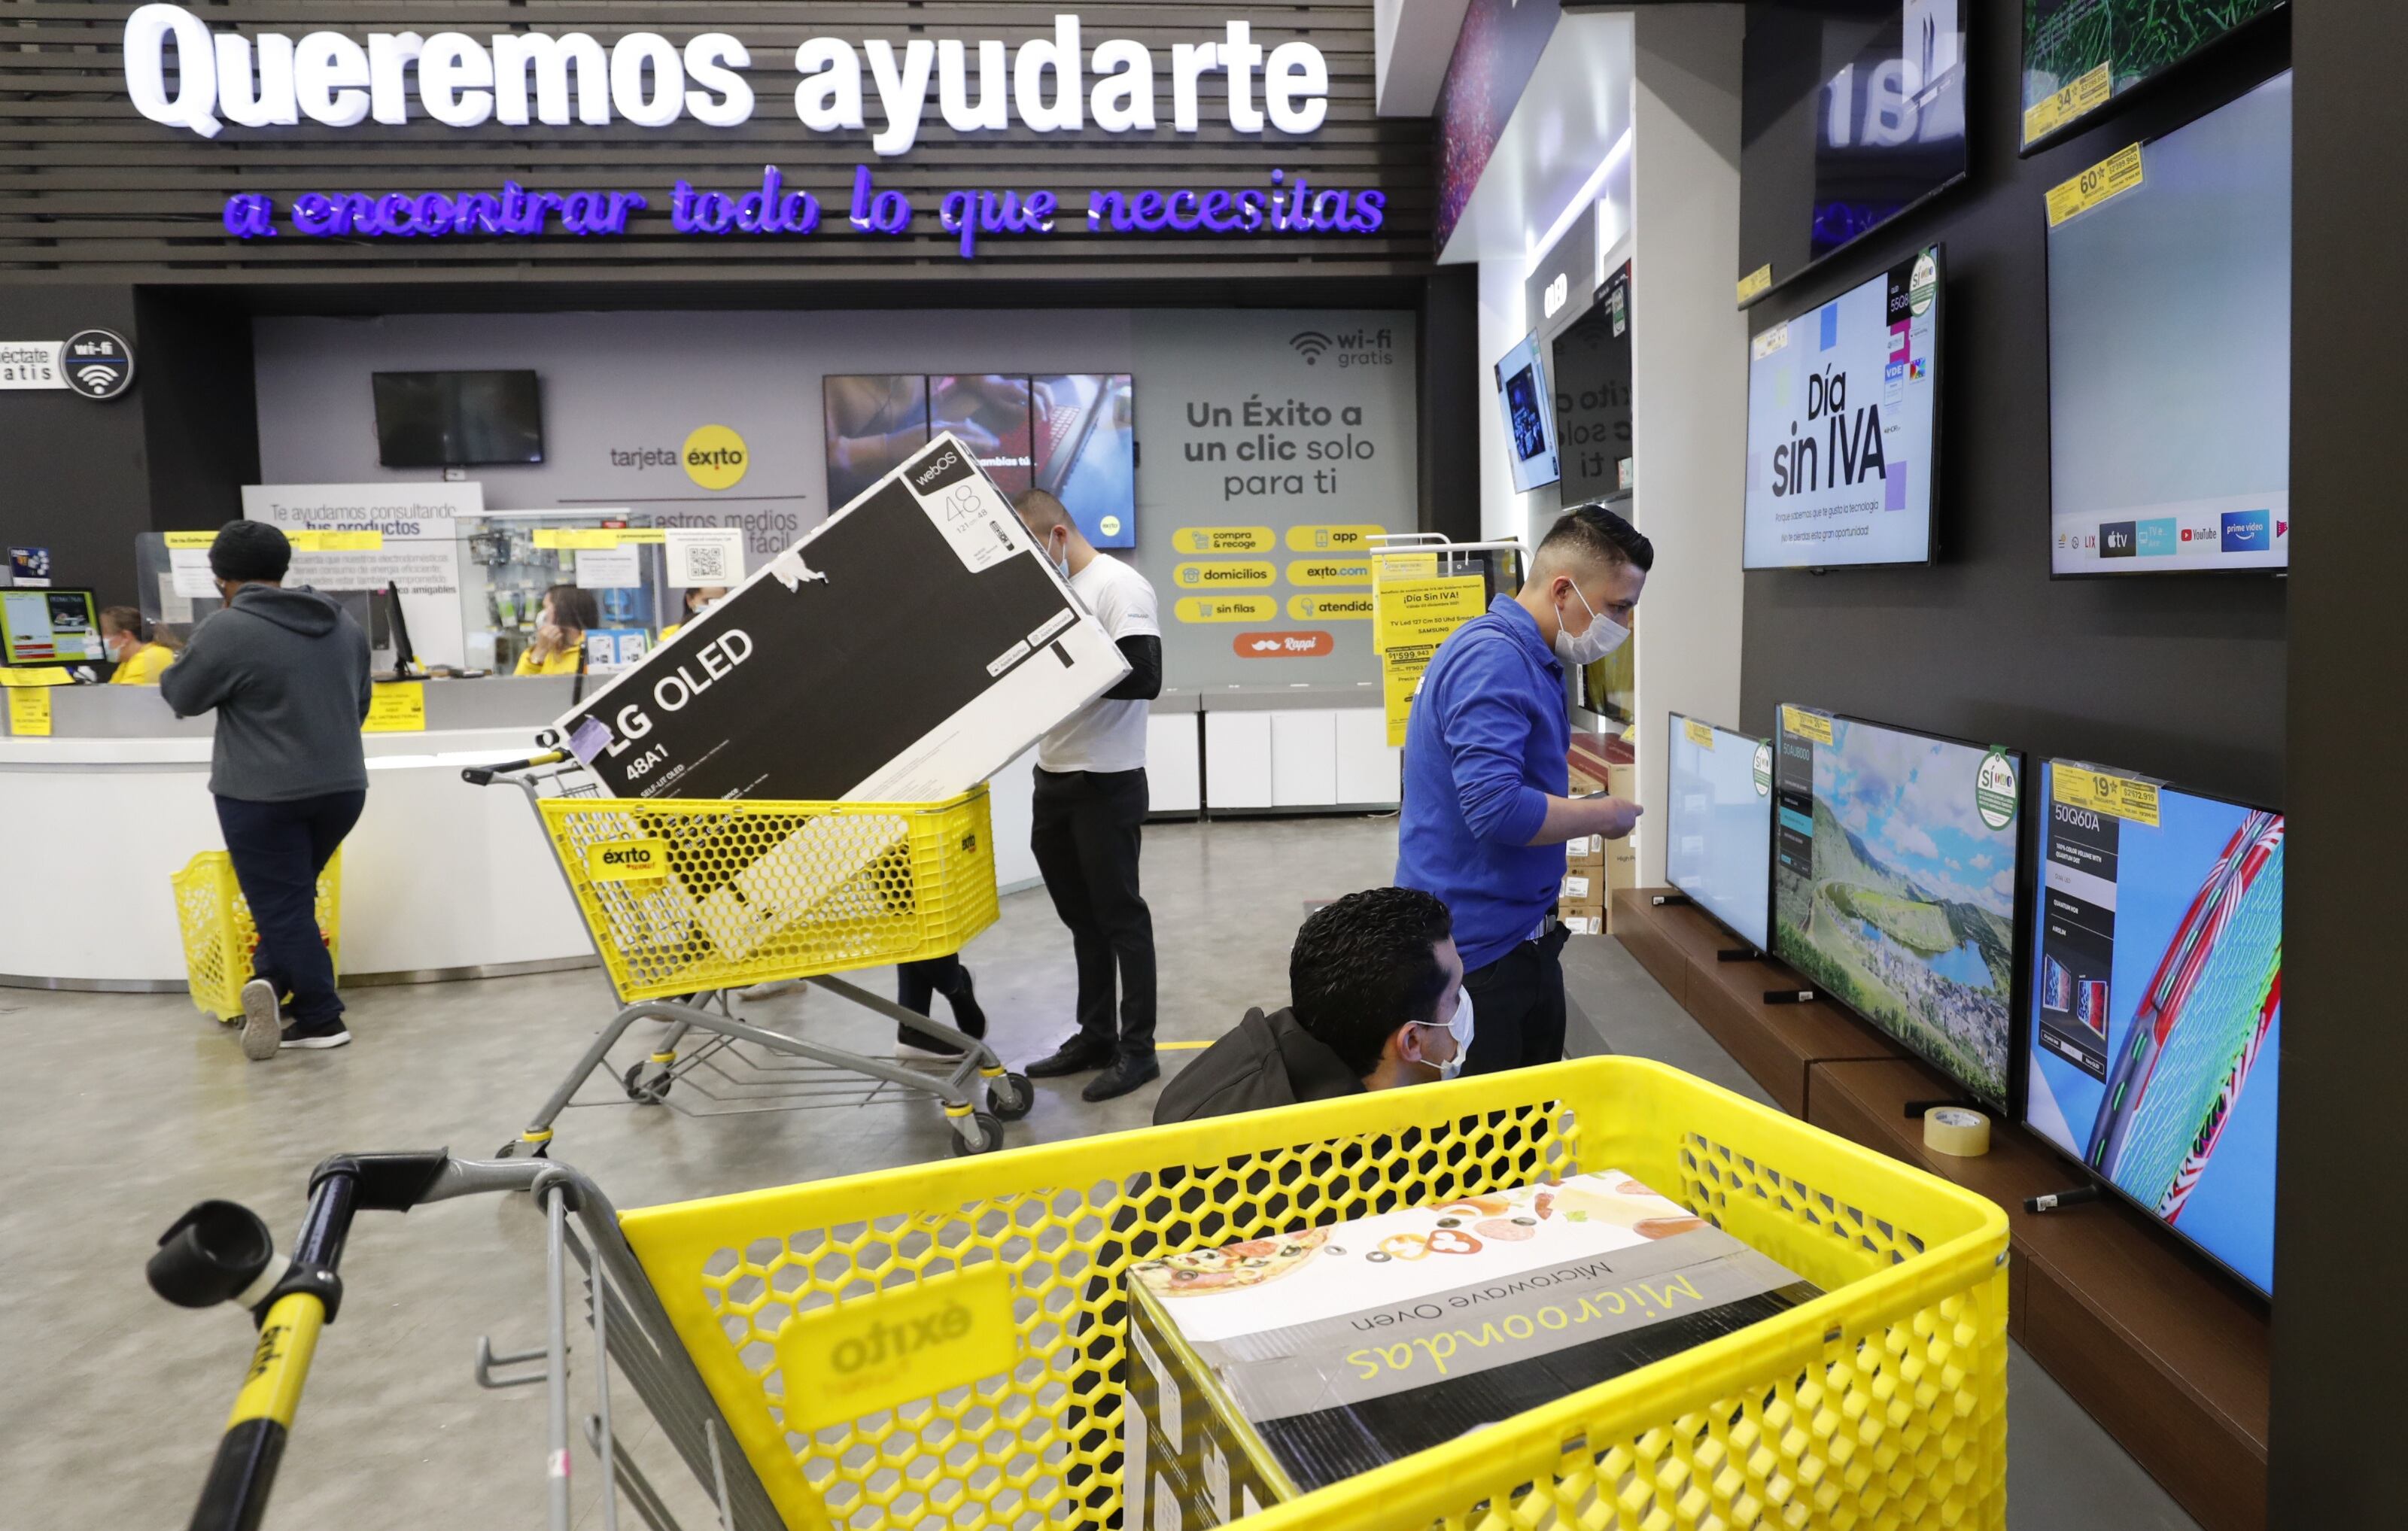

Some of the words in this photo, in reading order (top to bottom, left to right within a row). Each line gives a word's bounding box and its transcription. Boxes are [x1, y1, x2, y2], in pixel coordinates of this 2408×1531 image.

[123, 3, 755, 138] Queremos
[794, 14, 1329, 156] ayudarte
[2057, 88, 2072, 111] 34
[2080, 170, 2097, 194] 60
[222, 193, 277, 238] a
[292, 179, 647, 238] encontrar
[668, 166, 821, 234] todo
[849, 166, 911, 232] lo
[940, 187, 1057, 258] que
[1087, 169, 1387, 233] necesitas
[1890, 292, 1909, 313] 55Q8
[74, 342, 113, 355] wi-fi
[1337, 330, 1392, 349] wi-fi
[0, 347, 49, 363] éctate
[1337, 350, 1392, 368] gratis
[3, 364, 52, 381] atis
[1886, 364, 1902, 377] VDE
[1808, 363, 1847, 421] Día
[1187, 402, 1233, 427] Un
[1242, 393, 1332, 427] Éxito
[1341, 406, 1362, 427] a
[1184, 442, 1227, 462] un
[1236, 433, 1297, 461] clic
[1306, 433, 1375, 460] solo
[1772, 421, 1817, 497] sin
[1828, 403, 1887, 489] IVA
[610, 447, 676, 470] tarjeta
[686, 447, 743, 470] éxito
[916, 451, 958, 486] webOS
[1225, 474, 1303, 501] para
[1314, 467, 1336, 494] ti
[271, 504, 287, 521] Te
[291, 505, 366, 524] ayudamos
[369, 503, 458, 520] consultando
[946, 485, 981, 522] 48
[655, 513, 715, 528] estros
[725, 511, 798, 532] medios
[956, 522, 969, 534] 121
[977, 509, 988, 519] 48
[2227, 524, 2245, 535] prime
[2245, 523, 2264, 532] video
[749, 533, 791, 554] fácil
[1213, 531, 1251, 542] compra
[1222, 540, 1256, 549] recoge
[1333, 531, 1358, 543] app
[2116, 532, 2128, 548] tv
[2193, 528, 2217, 541] YouTube
[291, 554, 324, 564] ecuerda
[1204, 568, 1267, 580] domicilios
[412, 585, 456, 596] amigables
[1403, 594, 1421, 604] ¡Día
[1424, 593, 1438, 601] Sin
[1440, 591, 1459, 600] IVA!
[1216, 604, 1232, 614] sin
[1234, 603, 1255, 614] filas
[1284, 636, 1317, 652] Rappi
[605, 704, 653, 758] LG
[653, 629, 753, 712] OLED
[625, 743, 670, 781] 48A1
[666, 764, 686, 779] OLED
[1981, 764, 1996, 788] SÍ
[2092, 776, 2110, 797] 19
[720, 788, 740, 800] ience
[2055, 804, 2100, 833] 50Q60A
[603, 848, 651, 864] éxito
[1448, 1260, 1613, 1308] Microwave
[1346, 1274, 1704, 1381] Microondas
[1350, 1303, 1443, 1332] Oven
